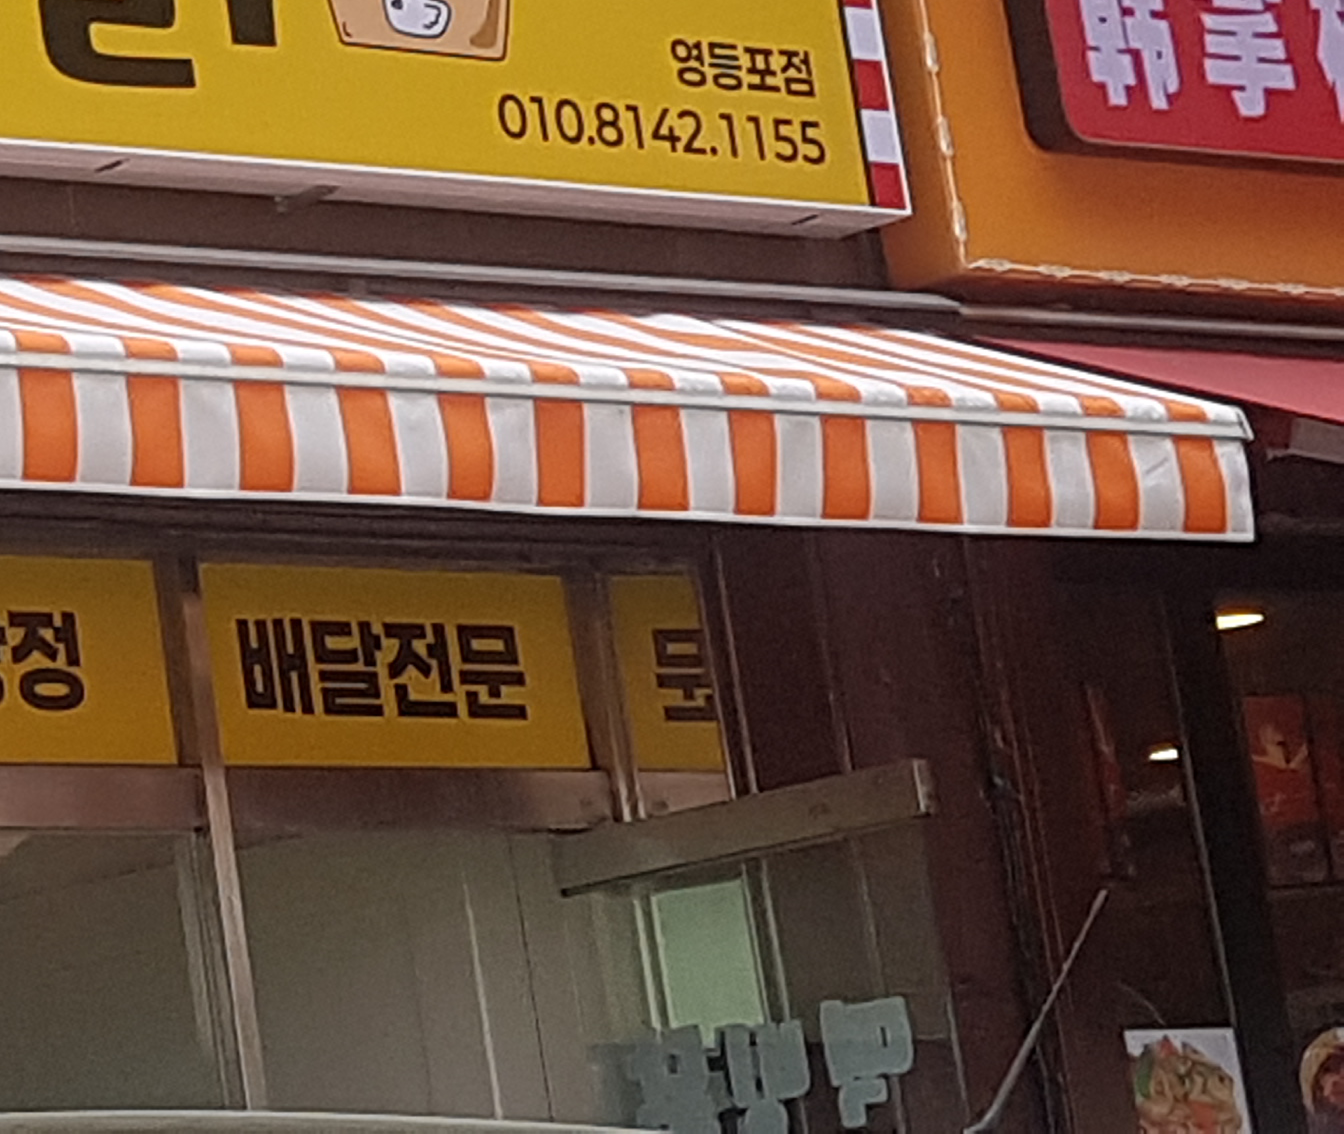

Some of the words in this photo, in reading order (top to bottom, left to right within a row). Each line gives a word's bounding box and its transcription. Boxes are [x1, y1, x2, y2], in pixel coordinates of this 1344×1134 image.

[670, 38, 816, 98] 영등포점
[497, 93, 827, 165] 010.8142.1155
[235, 618, 529, 720] 배달전문
